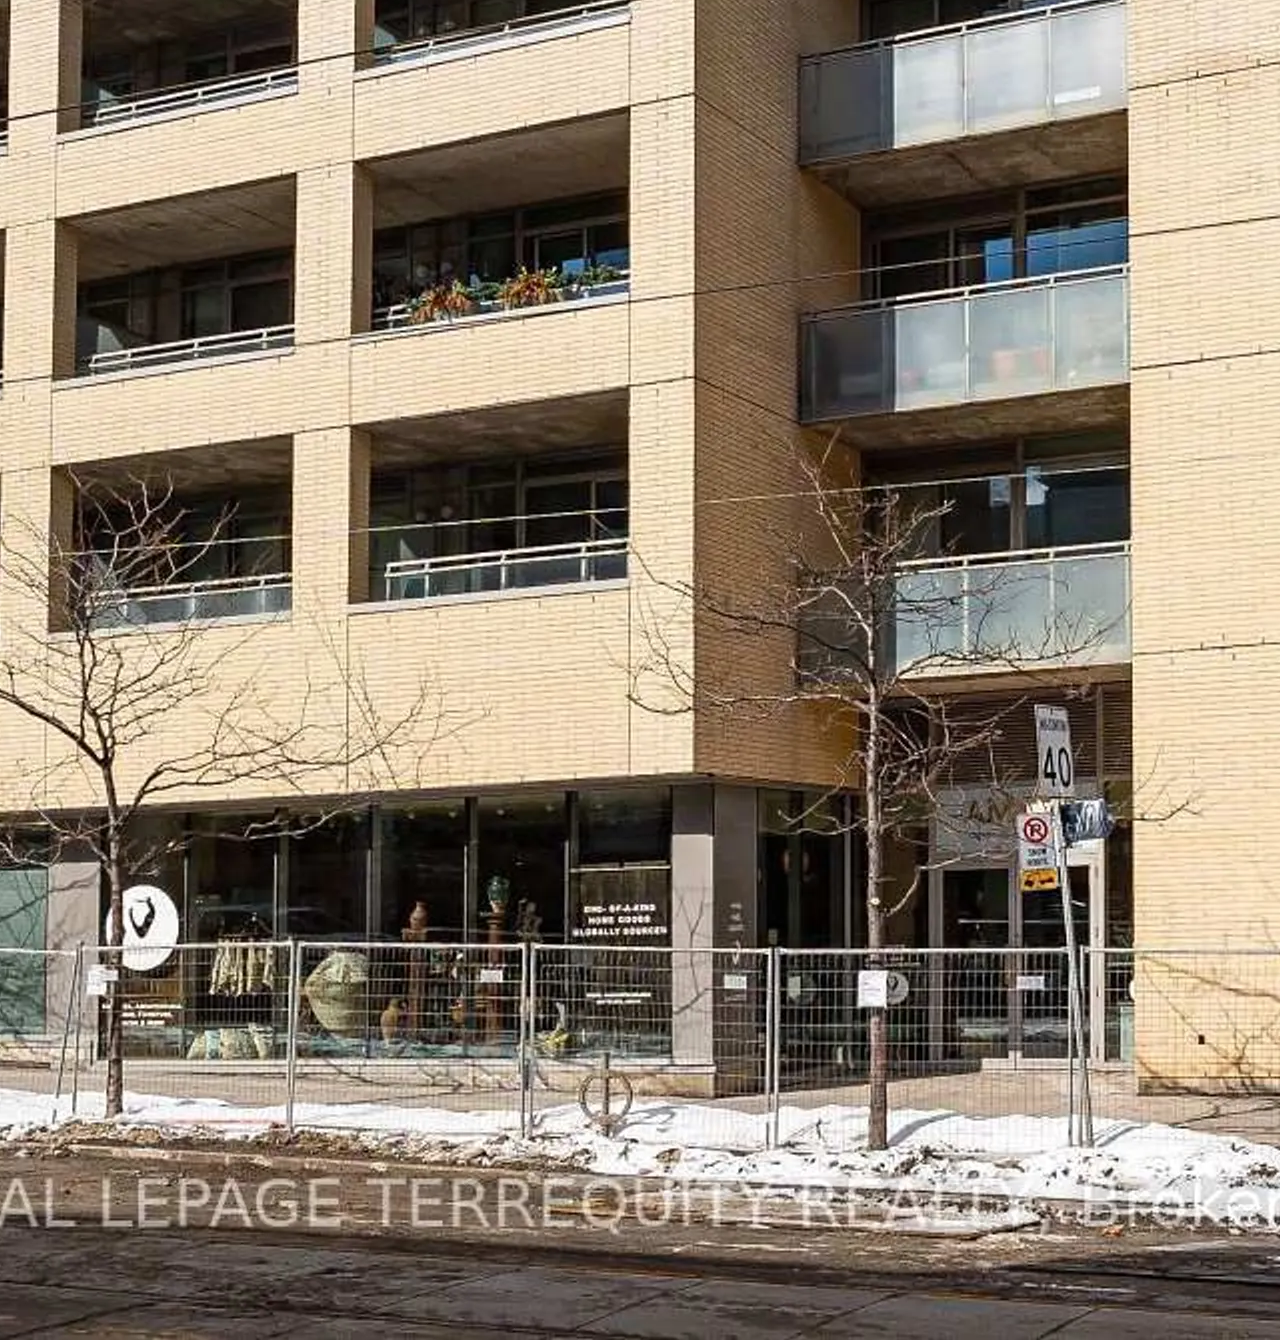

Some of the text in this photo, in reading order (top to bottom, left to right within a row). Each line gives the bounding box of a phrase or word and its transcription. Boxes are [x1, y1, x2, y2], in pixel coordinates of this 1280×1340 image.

[1044, 746, 1072, 788] 40
[1028, 848, 1048, 857] SNOW
[588, 915, 652, 926] HOME GOODS
[572, 925, 668, 937] GLOBALLY SOURCED
